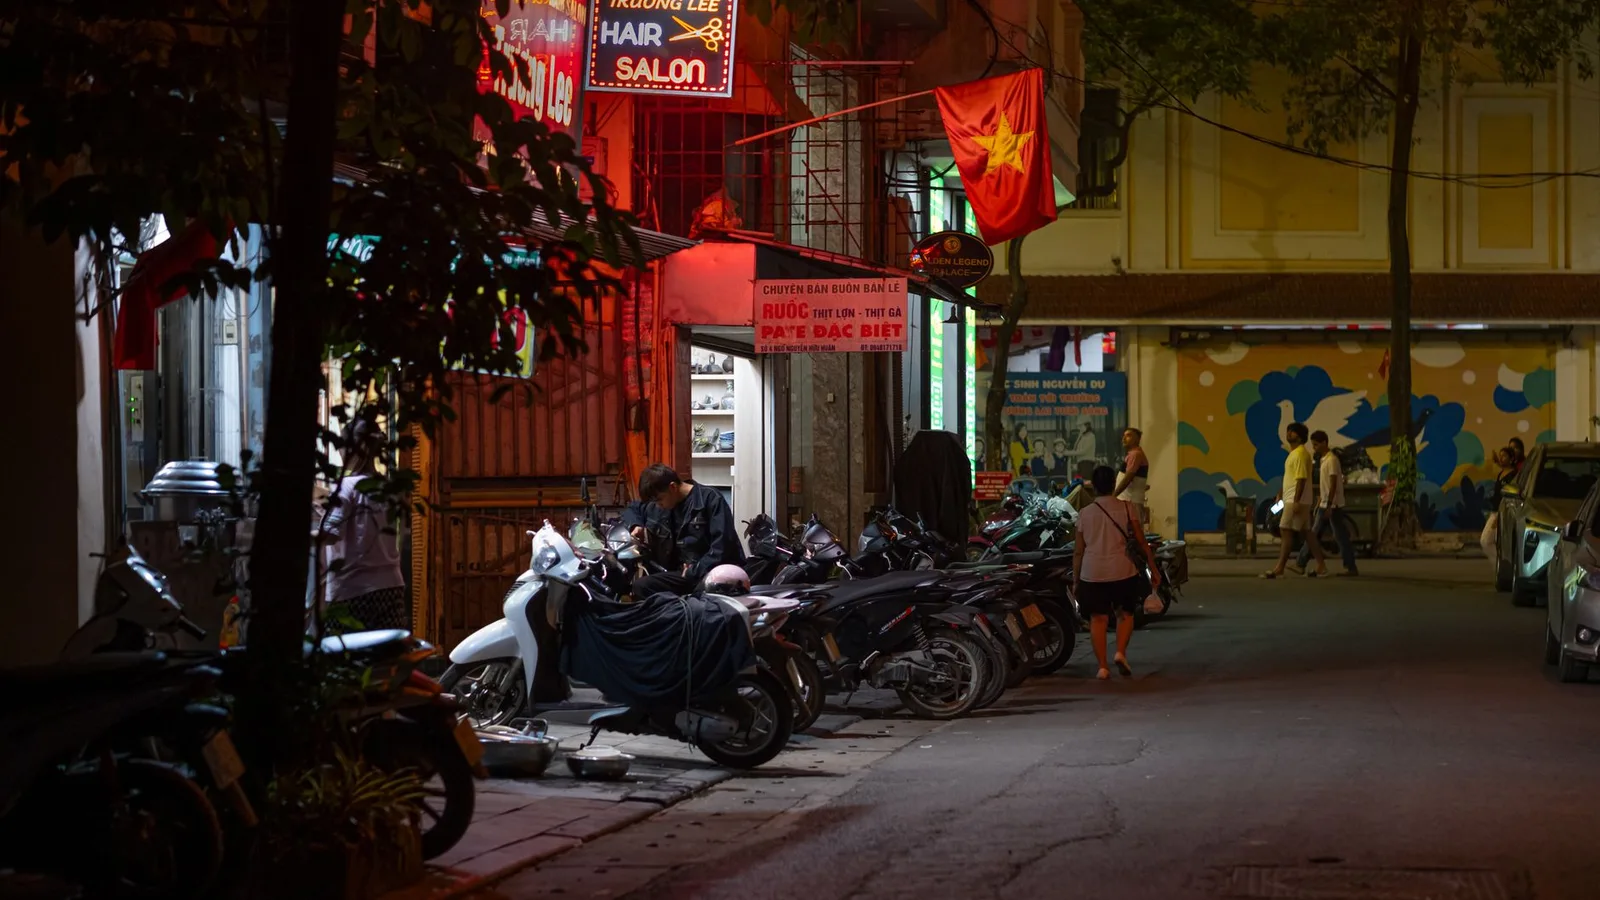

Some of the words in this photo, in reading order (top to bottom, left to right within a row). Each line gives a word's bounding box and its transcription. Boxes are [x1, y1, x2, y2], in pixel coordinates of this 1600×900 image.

[601, 20, 662, 46] HAIR
[615, 56, 705, 84] SALON
[547, 54, 573, 127] Lee
[933, 268, 970, 276] PALACE
[953, 258, 989, 266] LEGEND
[763, 282, 804, 295] CHUYÊN
[807, 282, 829, 294] BÁN
[831, 281, 860, 294] BUÔN
[863, 281, 885, 293] BÁN
[762, 298, 809, 319] RUỐC
[813, 308, 833, 320] THỊT
[836, 308, 855, 319] LỢN
[865, 308, 885, 320] THỊT
[888, 306, 901, 318] GÀ
[813, 323, 853, 341] ĐẶC
[860, 321, 902, 341] BIỆT
[1013, 379, 1039, 389] SINH
[1090, 380, 1106, 389] DU
